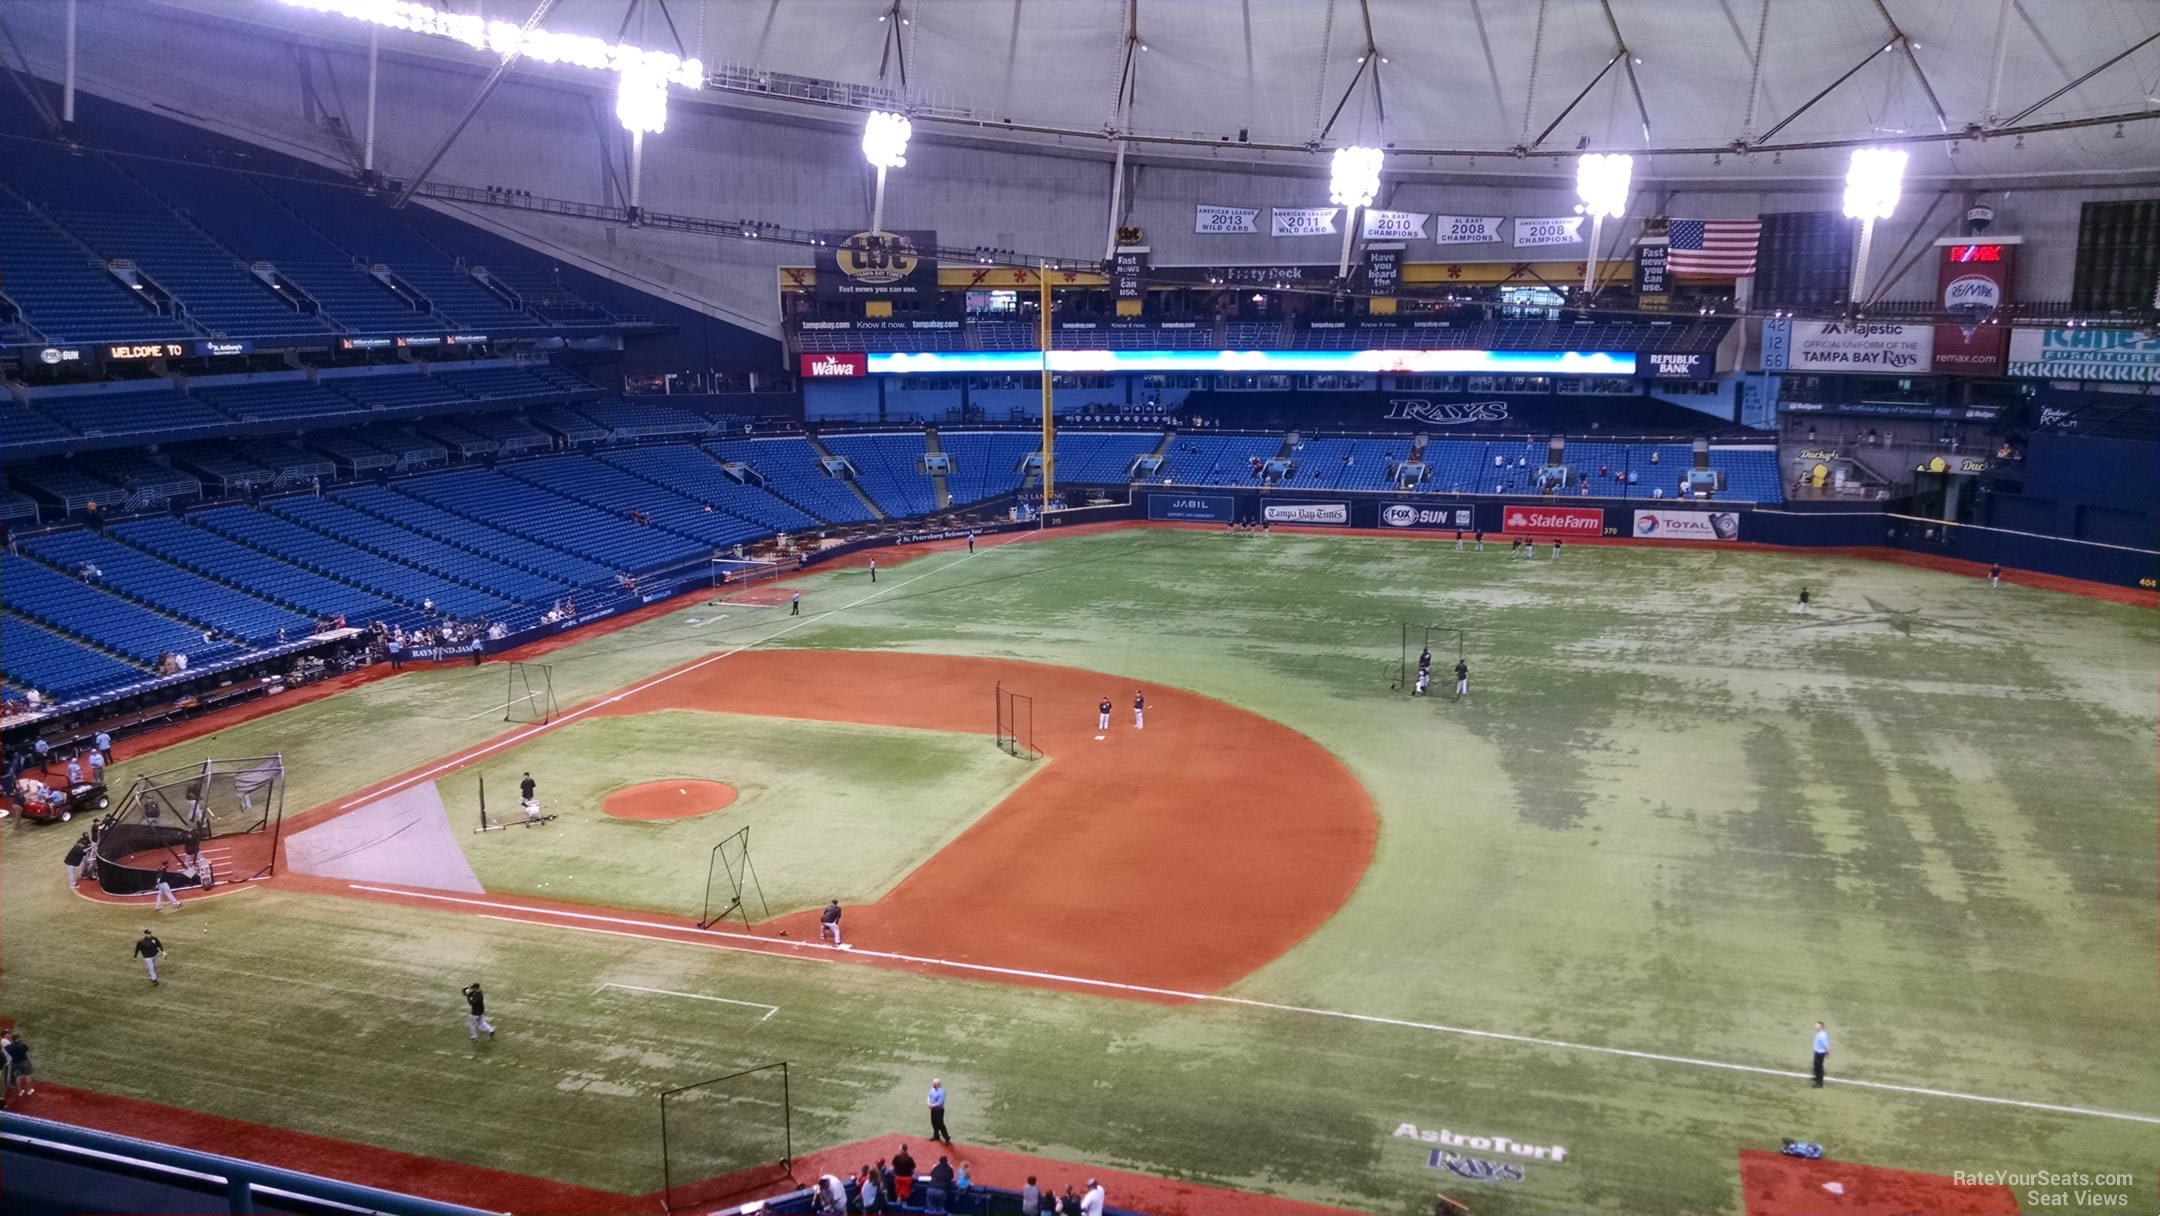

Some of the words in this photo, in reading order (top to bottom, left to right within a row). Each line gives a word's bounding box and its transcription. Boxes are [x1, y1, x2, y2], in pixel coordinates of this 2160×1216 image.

[1212, 215, 1242, 225] 2013
[1288, 217, 1319, 227] 2011
[1378, 219, 1411, 230] 2010
[1368, 229, 1418, 238] CHAMPIONS
[1452, 224, 1485, 234] 2008
[1530, 225, 1565, 237] 2008
[1519, 236, 1574, 244] CHAMPIONS
[851, 236, 908, 270] tbt
[1371, 253, 1395, 262] Have
[1643, 248, 1664, 257] Fast
[1118, 256, 1137, 264] Fast
[1641, 258, 1668, 266] news
[1374, 263, 1391, 272] you
[1644, 267, 1663, 276] you
[1368, 269, 1397, 278] heard
[1644, 275, 1663, 283] can
[1951, 283, 1993, 298] RE/MAX
[802, 321, 850, 330] tampabay.com
[857, 321, 880, 329] Know
[881, 321, 887, 329] it
[912, 320, 959, 329] tampabay.com
[1768, 321, 1785, 332] 42
[1769, 337, 1783, 349] 12
[1843, 341, 1884, 349] UNIFORM
[1901, 342, 1918, 350] THE
[63, 351, 79, 360] SUN
[111, 346, 162, 358] WELCOME
[167, 345, 182, 357] TO
[2045, 351, 2156, 362] FURNITURE
[1650, 354, 1700, 364] REPUBLIC
[1765, 354, 1783, 367] 66
[1803, 352, 1849, 362] TAMPA
[1852, 353, 1880, 363] BAY
[1881, 350, 1917, 368] RAYS
[1936, 354, 1996, 363] remax.com
[811, 361, 855, 376] Wawa
[1659, 364, 1689, 373] BANK
[1384, 399, 1508, 425] RAYS
[1173, 500, 1209, 509] JABIL
[1268, 508, 1297, 520] Tampa
[1298, 508, 1316, 520] Bay
[1316, 508, 1343, 519] Times
[1391, 509, 1411, 519] FOX
[1419, 510, 1448, 524] SUN
[1663, 519, 1709, 529] TOTAL
[2138, 578, 2157, 588] 404
[412, 647, 456, 657] RAYMND
[455, 644, 483, 654] JAMS
[1393, 1122, 1568, 1162] AstroTurf
[1427, 1149, 1526, 1184] RAYS
